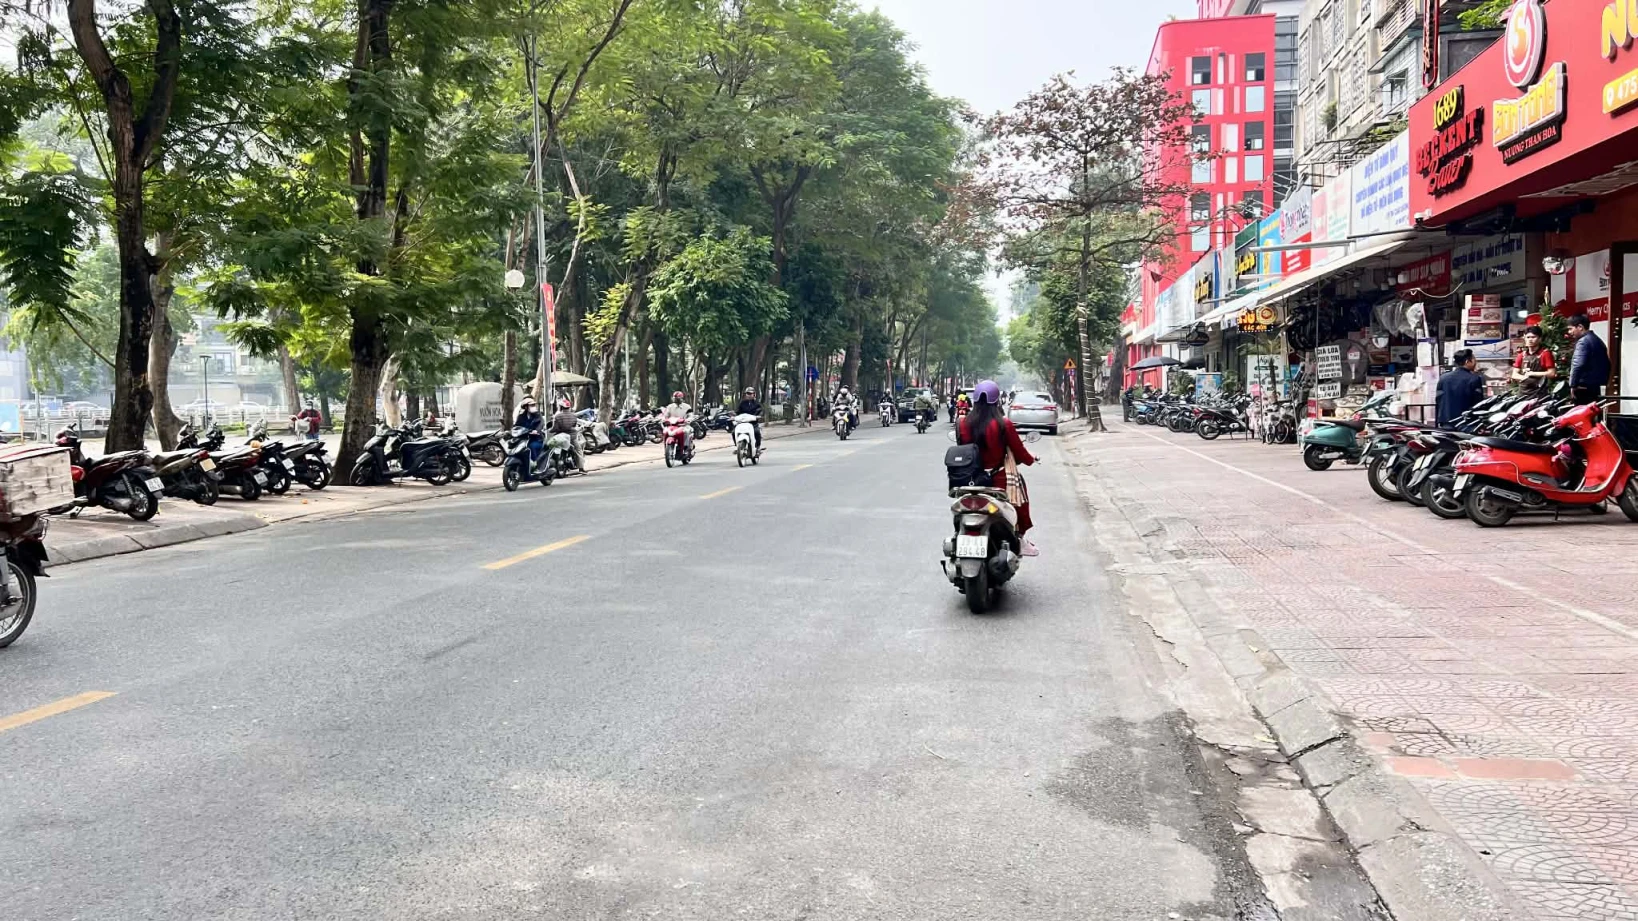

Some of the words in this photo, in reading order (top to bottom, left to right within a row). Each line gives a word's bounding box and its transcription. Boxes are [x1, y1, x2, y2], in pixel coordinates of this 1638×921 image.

[1617, 74, 1638, 100] 475
[1433, 87, 1457, 130] 1689
[1525, 131, 1542, 149] THAN
